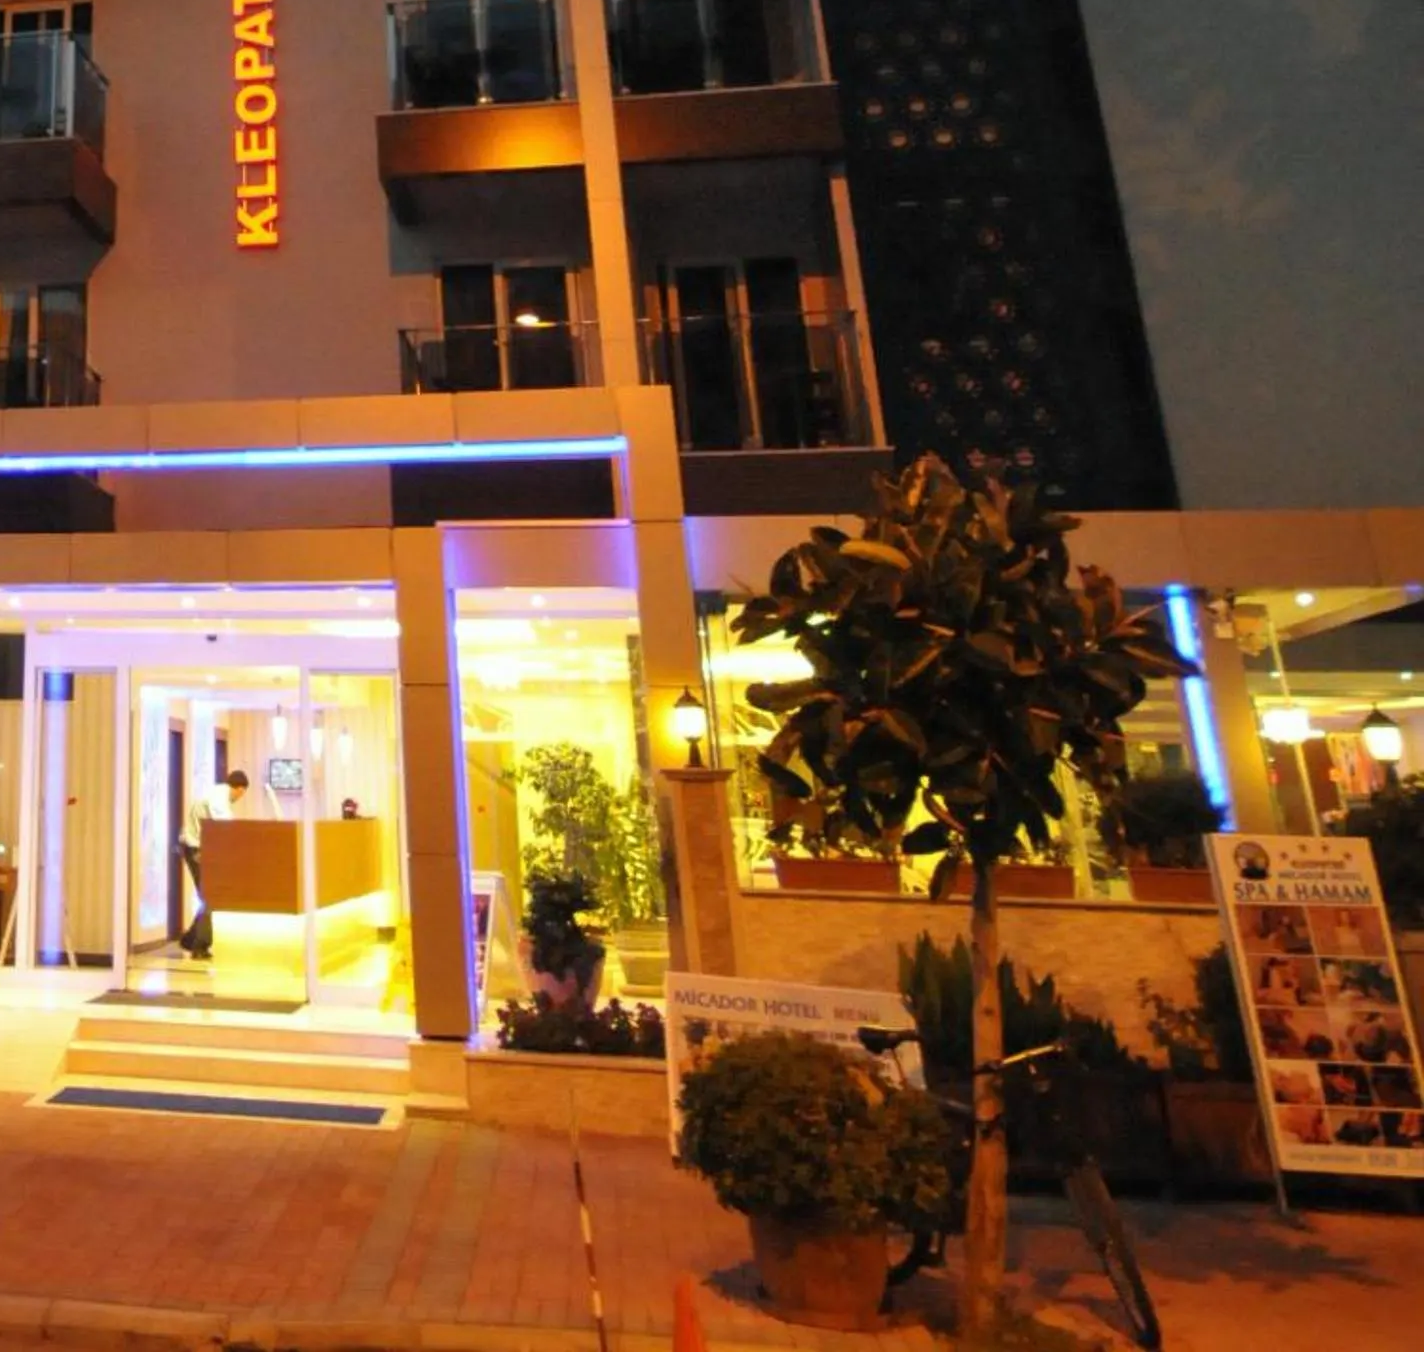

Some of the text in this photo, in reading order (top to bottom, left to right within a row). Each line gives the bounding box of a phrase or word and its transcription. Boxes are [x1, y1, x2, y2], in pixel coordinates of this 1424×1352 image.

[1234, 882, 1371, 902] SPA & HAMAM
[764, 1001, 822, 1020] HOTEL
